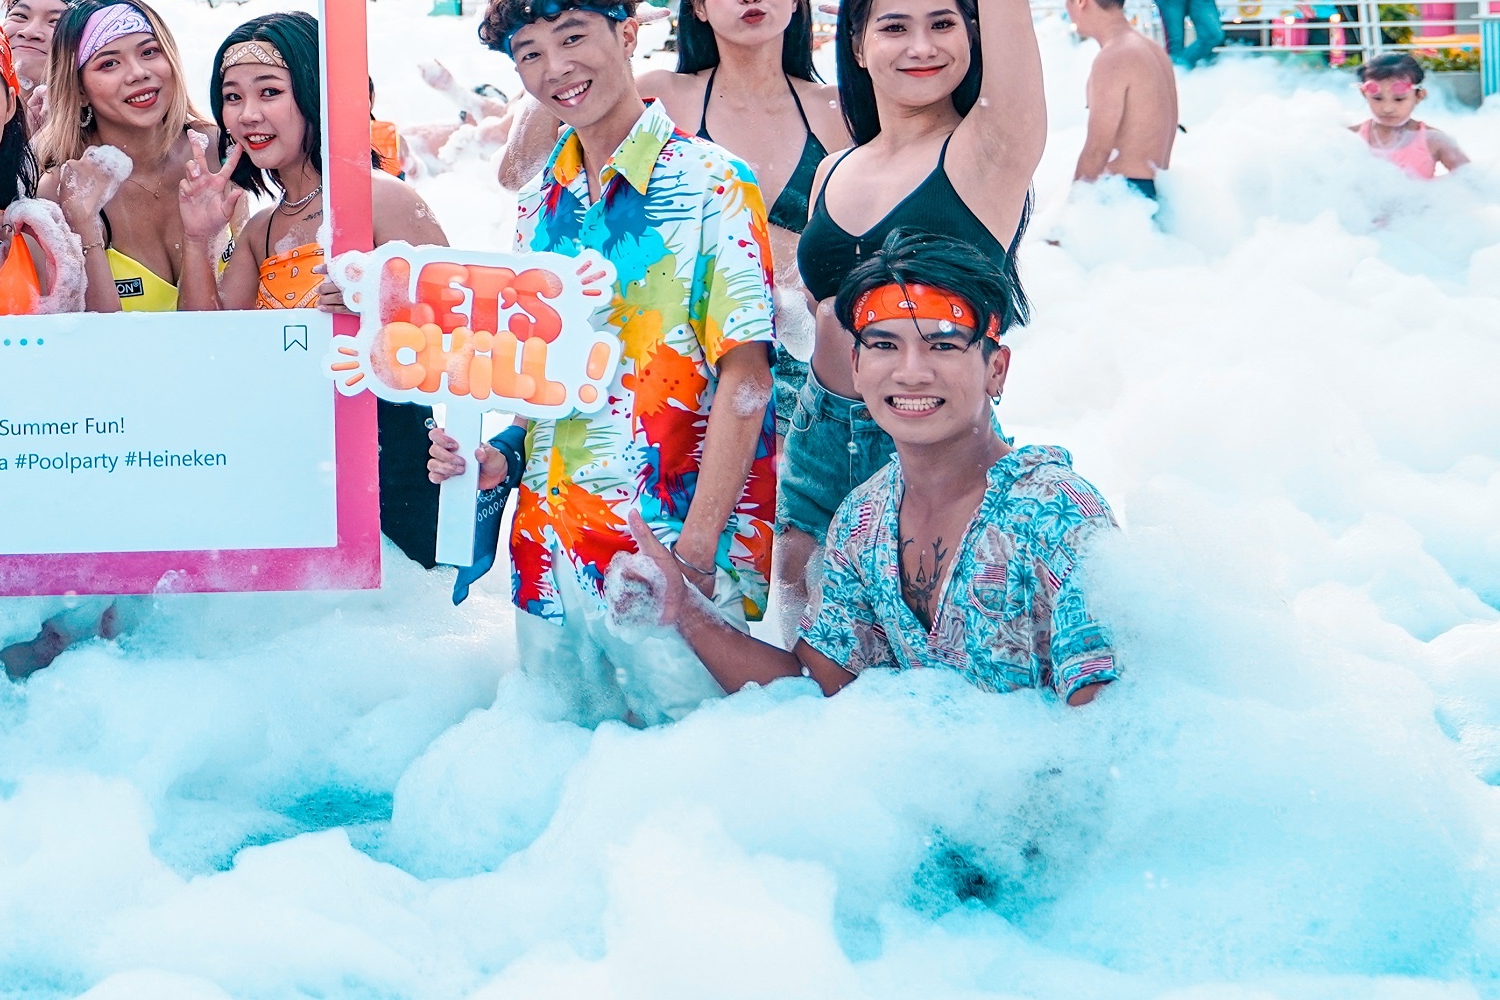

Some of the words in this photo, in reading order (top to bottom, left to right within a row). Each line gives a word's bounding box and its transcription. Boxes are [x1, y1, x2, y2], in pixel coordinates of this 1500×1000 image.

[378, 256, 564, 345] LET'S
[0, 418, 79, 437] Summer
[85, 416, 125, 435] Fun!
[14, 451, 119, 474] #Poolparty
[125, 448, 227, 468] #Heineken
